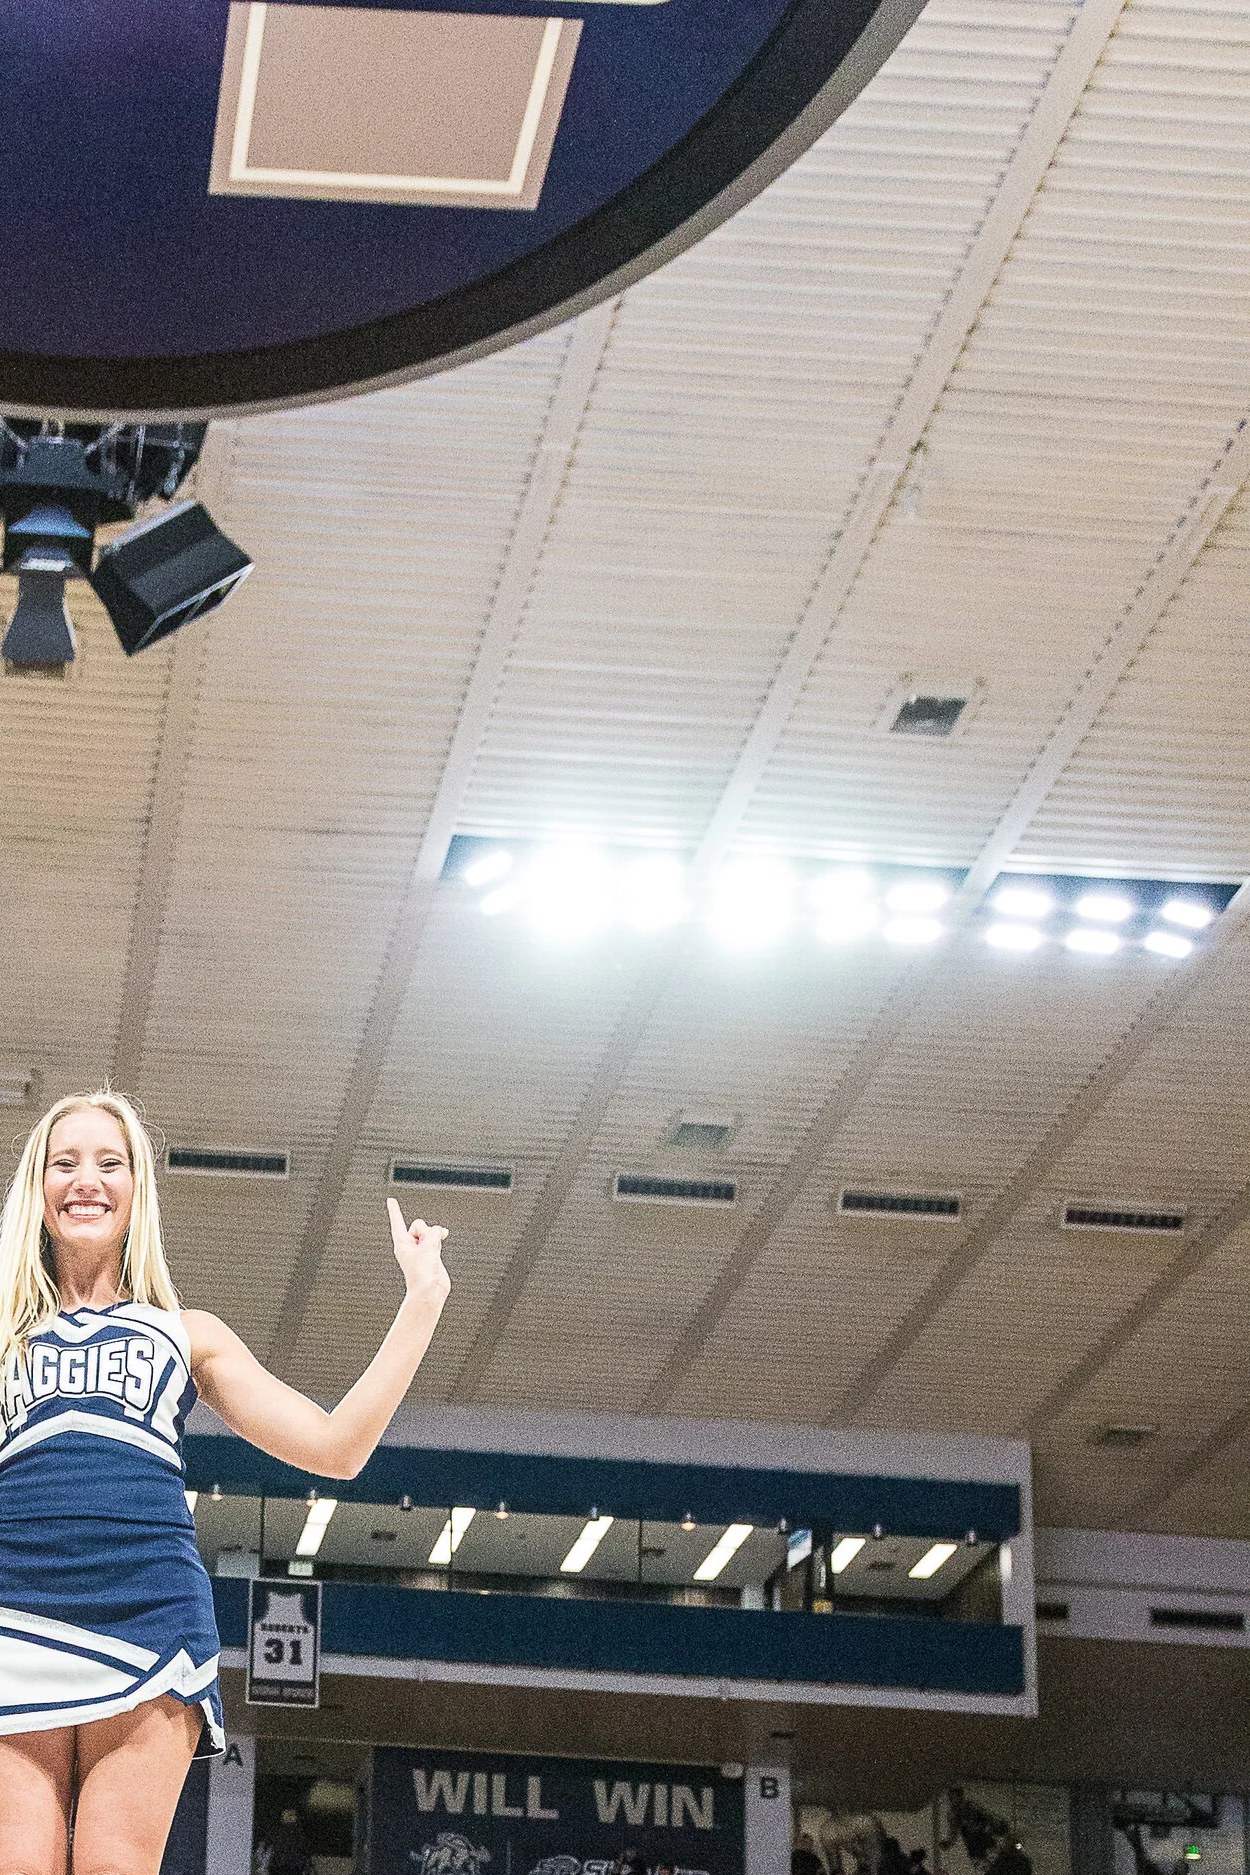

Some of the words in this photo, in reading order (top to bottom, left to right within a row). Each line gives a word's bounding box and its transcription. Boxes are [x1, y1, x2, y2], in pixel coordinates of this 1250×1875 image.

[2, 1336, 154, 1422] AGGIES
[263, 1638, 303, 1666] 31
[223, 1743, 244, 1767] A
[412, 1768, 559, 1821] WILL
[593, 1778, 716, 1830] WIN
[760, 1776, 780, 1800] B
